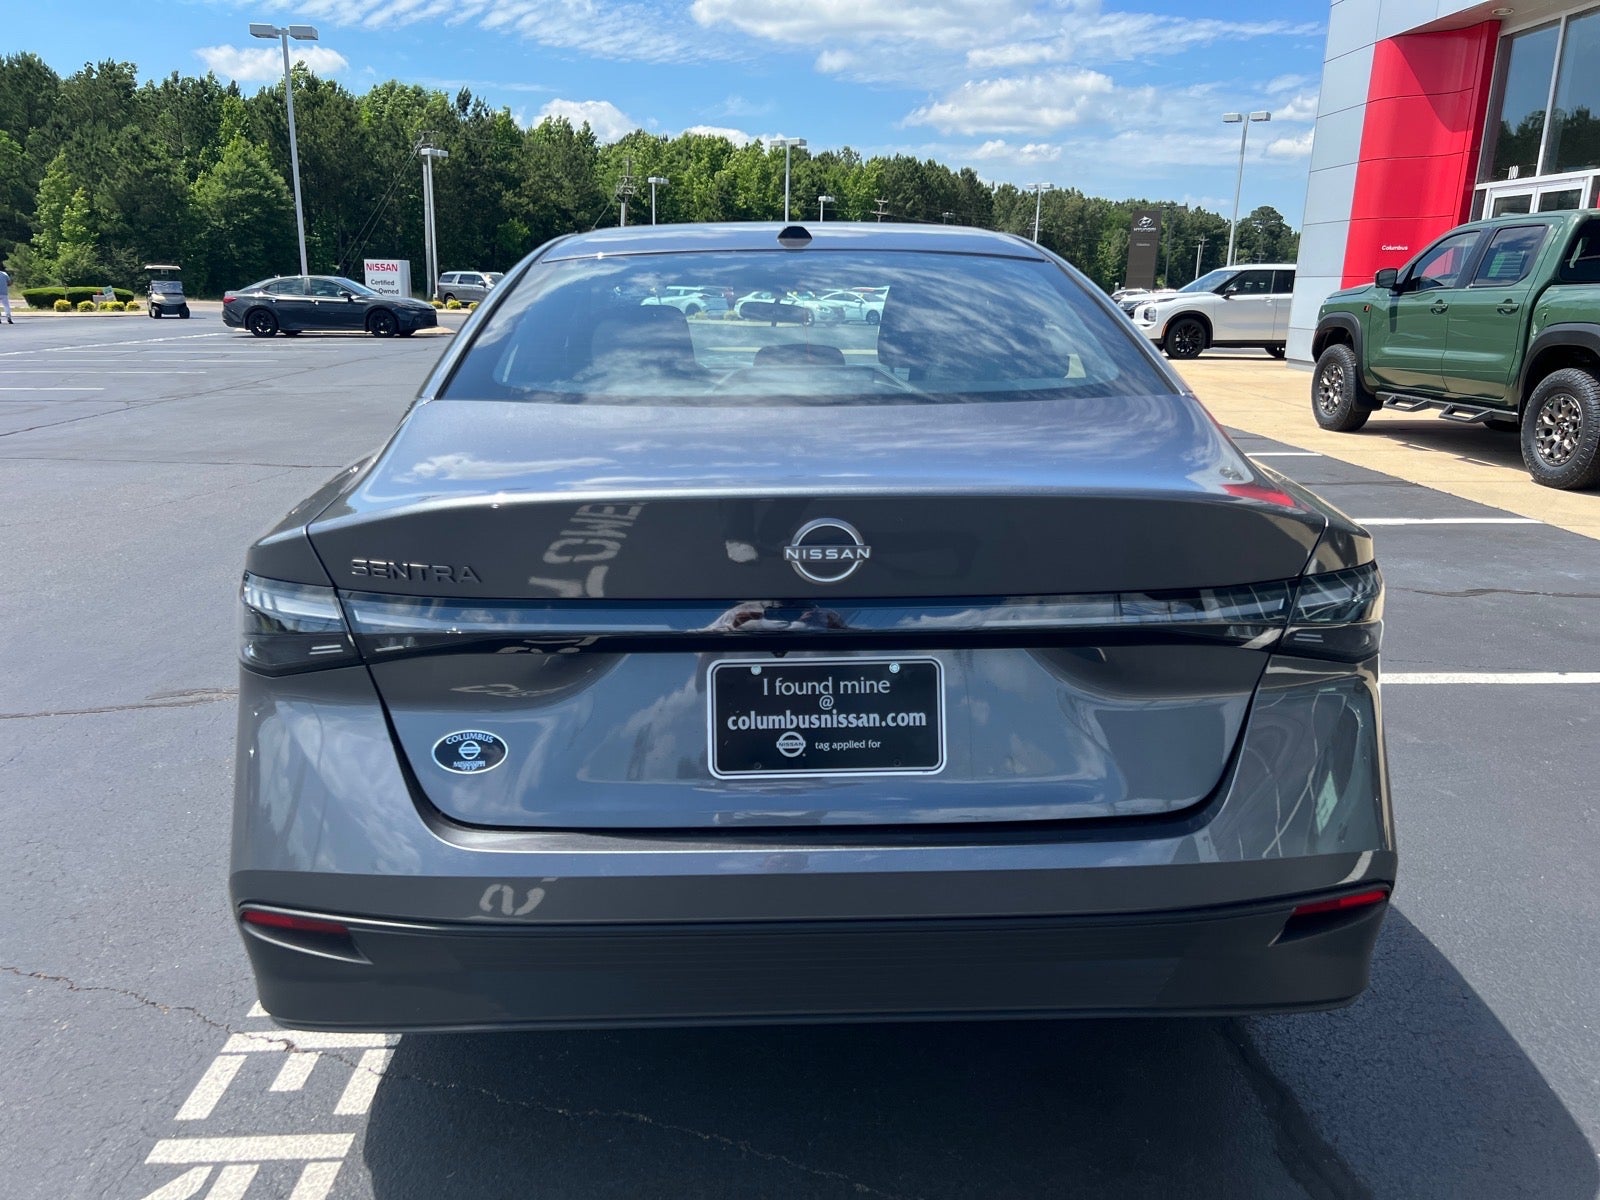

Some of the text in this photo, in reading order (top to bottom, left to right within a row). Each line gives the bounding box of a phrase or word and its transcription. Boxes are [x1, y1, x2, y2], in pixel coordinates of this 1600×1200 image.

[366, 263, 398, 271] NISSAN
[785, 548, 870, 560] NISSAN
[351, 559, 482, 583] SENTRA
[775, 676, 833, 696] found
[839, 676, 891, 694] mine
[819, 695, 834, 711] @
[727, 708, 927, 731] columbusnissan.com
[446, 733, 493, 744] COLUMBUS
[815, 739, 881, 752] tag applied for
